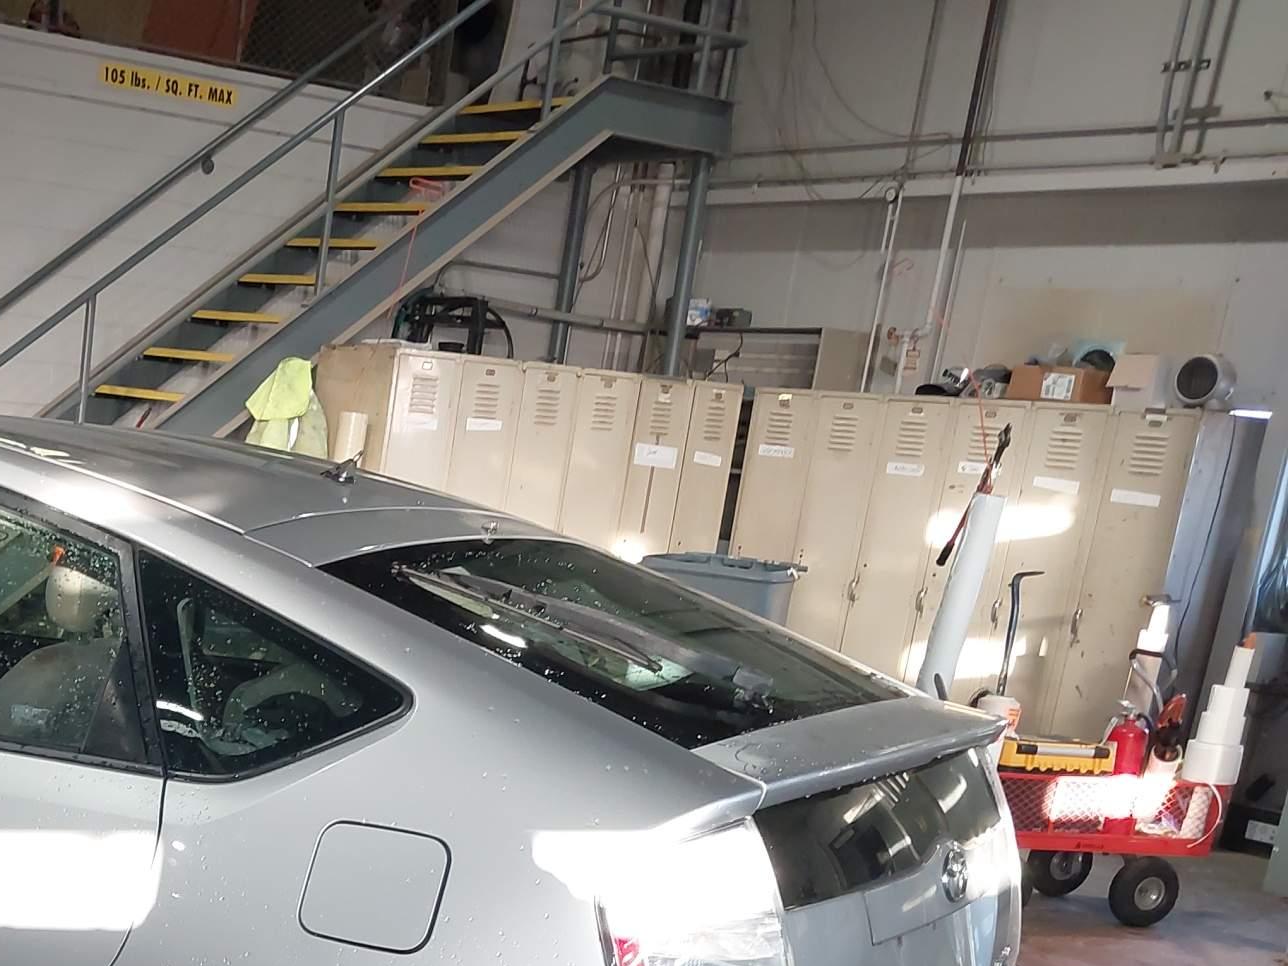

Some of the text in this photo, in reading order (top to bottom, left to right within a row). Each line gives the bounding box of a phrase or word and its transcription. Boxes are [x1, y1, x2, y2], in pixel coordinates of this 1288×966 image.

[105, 66, 125, 84] 105
[131, 71, 150, 90] lbs.
[165, 78, 182, 96] SQ.
[188, 83, 202, 99] FT.
[208, 87, 232, 104] MAX
